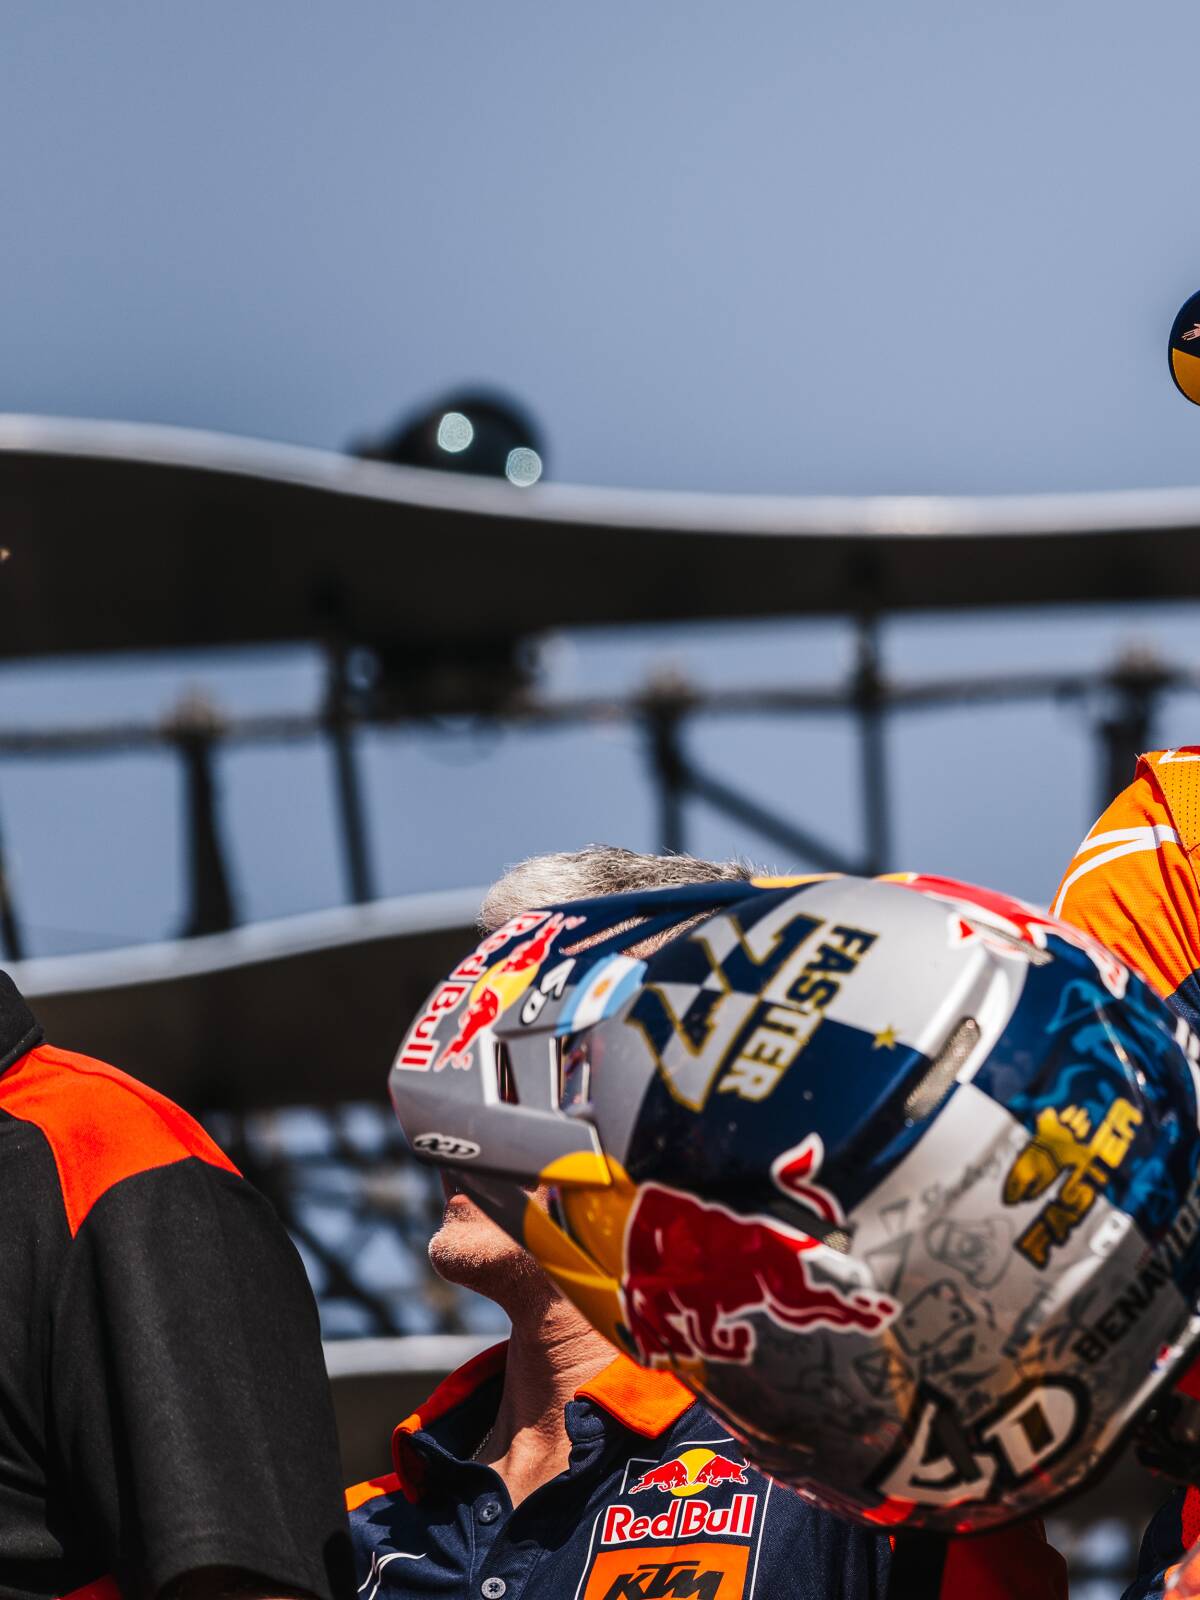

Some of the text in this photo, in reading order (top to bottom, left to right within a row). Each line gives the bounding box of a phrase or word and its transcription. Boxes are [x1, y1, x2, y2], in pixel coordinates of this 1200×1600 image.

[450, 910, 553, 981] Red
[396, 980, 474, 1073] Bull
[718, 924, 879, 1102] FASTER
[1013, 1098, 1143, 1271] FASTER
[601, 1493, 758, 1544] Red Bull
[602, 1560, 725, 1600] KTM
